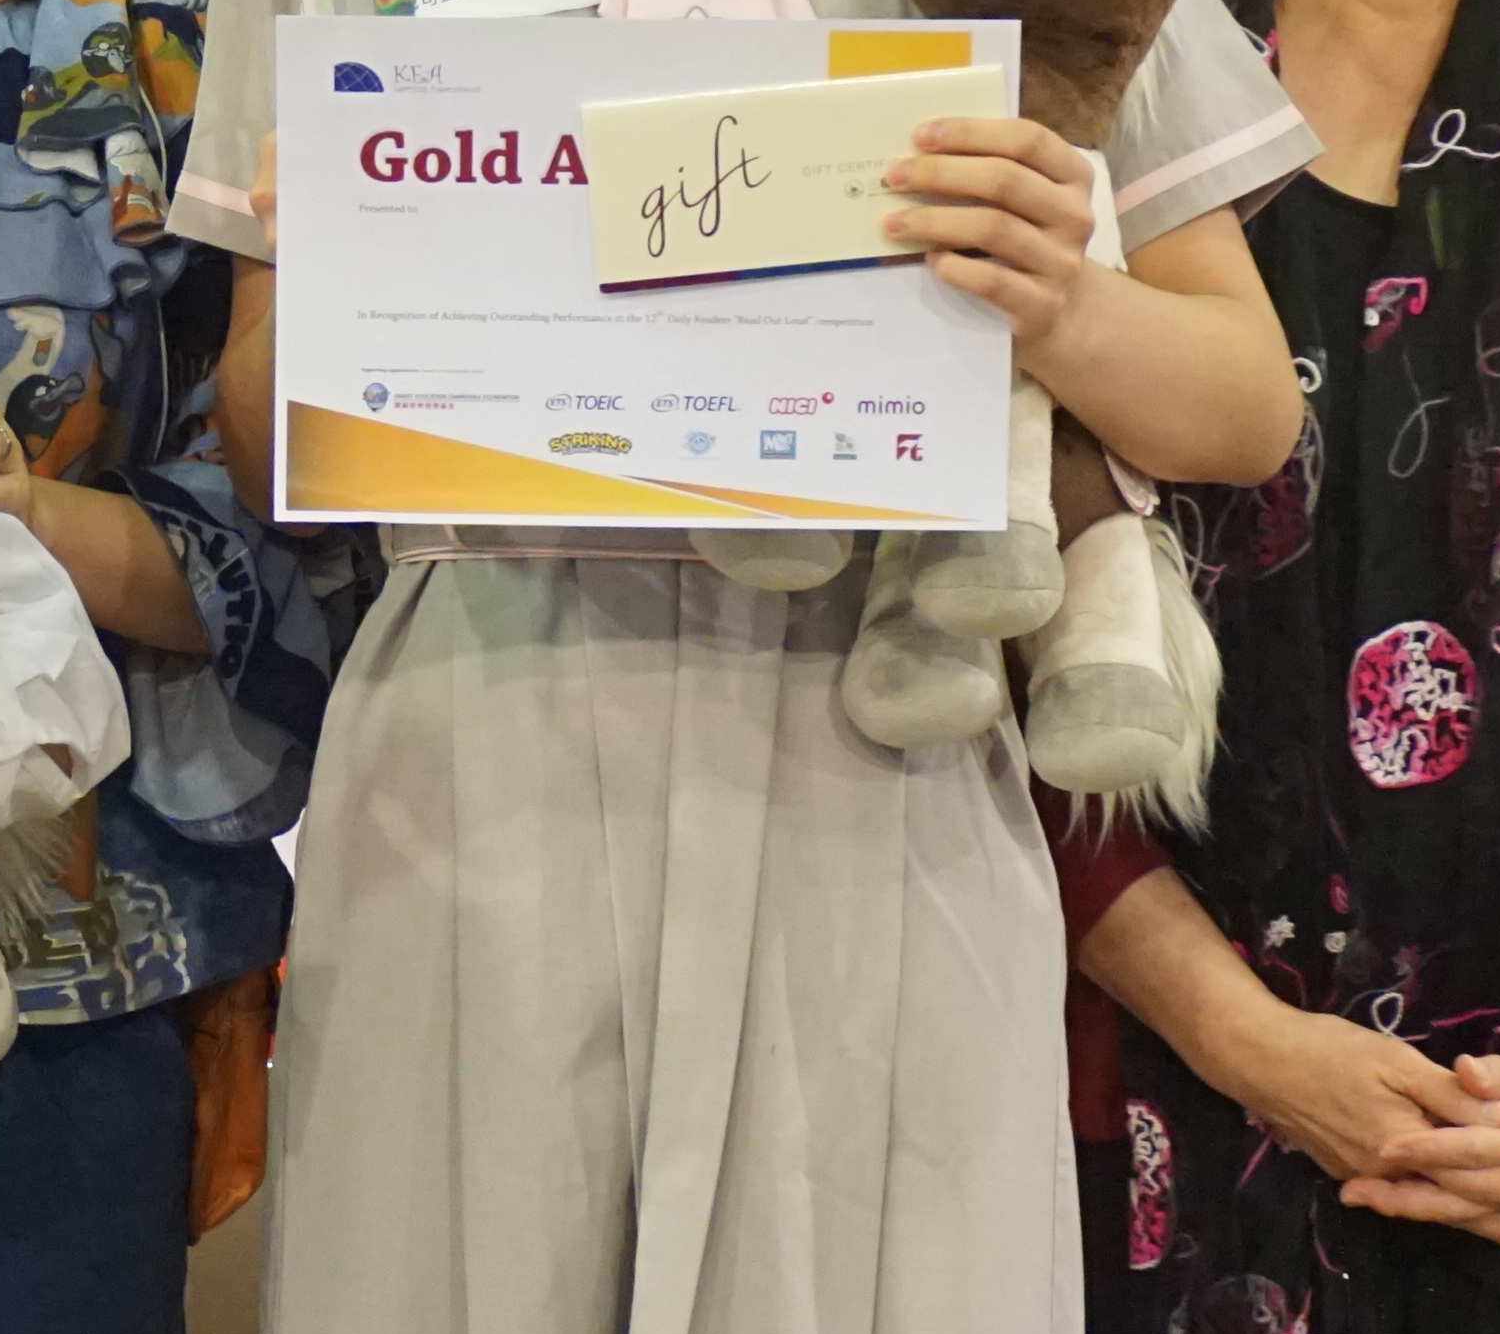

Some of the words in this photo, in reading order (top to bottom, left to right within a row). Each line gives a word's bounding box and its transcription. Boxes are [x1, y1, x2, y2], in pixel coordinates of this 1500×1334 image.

[360, 129, 522, 184] Gold
[641, 114, 772, 258] gift
[575, 395, 623, 410] TOEIC
[683, 396, 737, 411] TOEFL
[769, 397, 817, 415] NICI
[858, 395, 925, 415] mimio
[548, 432, 632, 454] STRIKING
